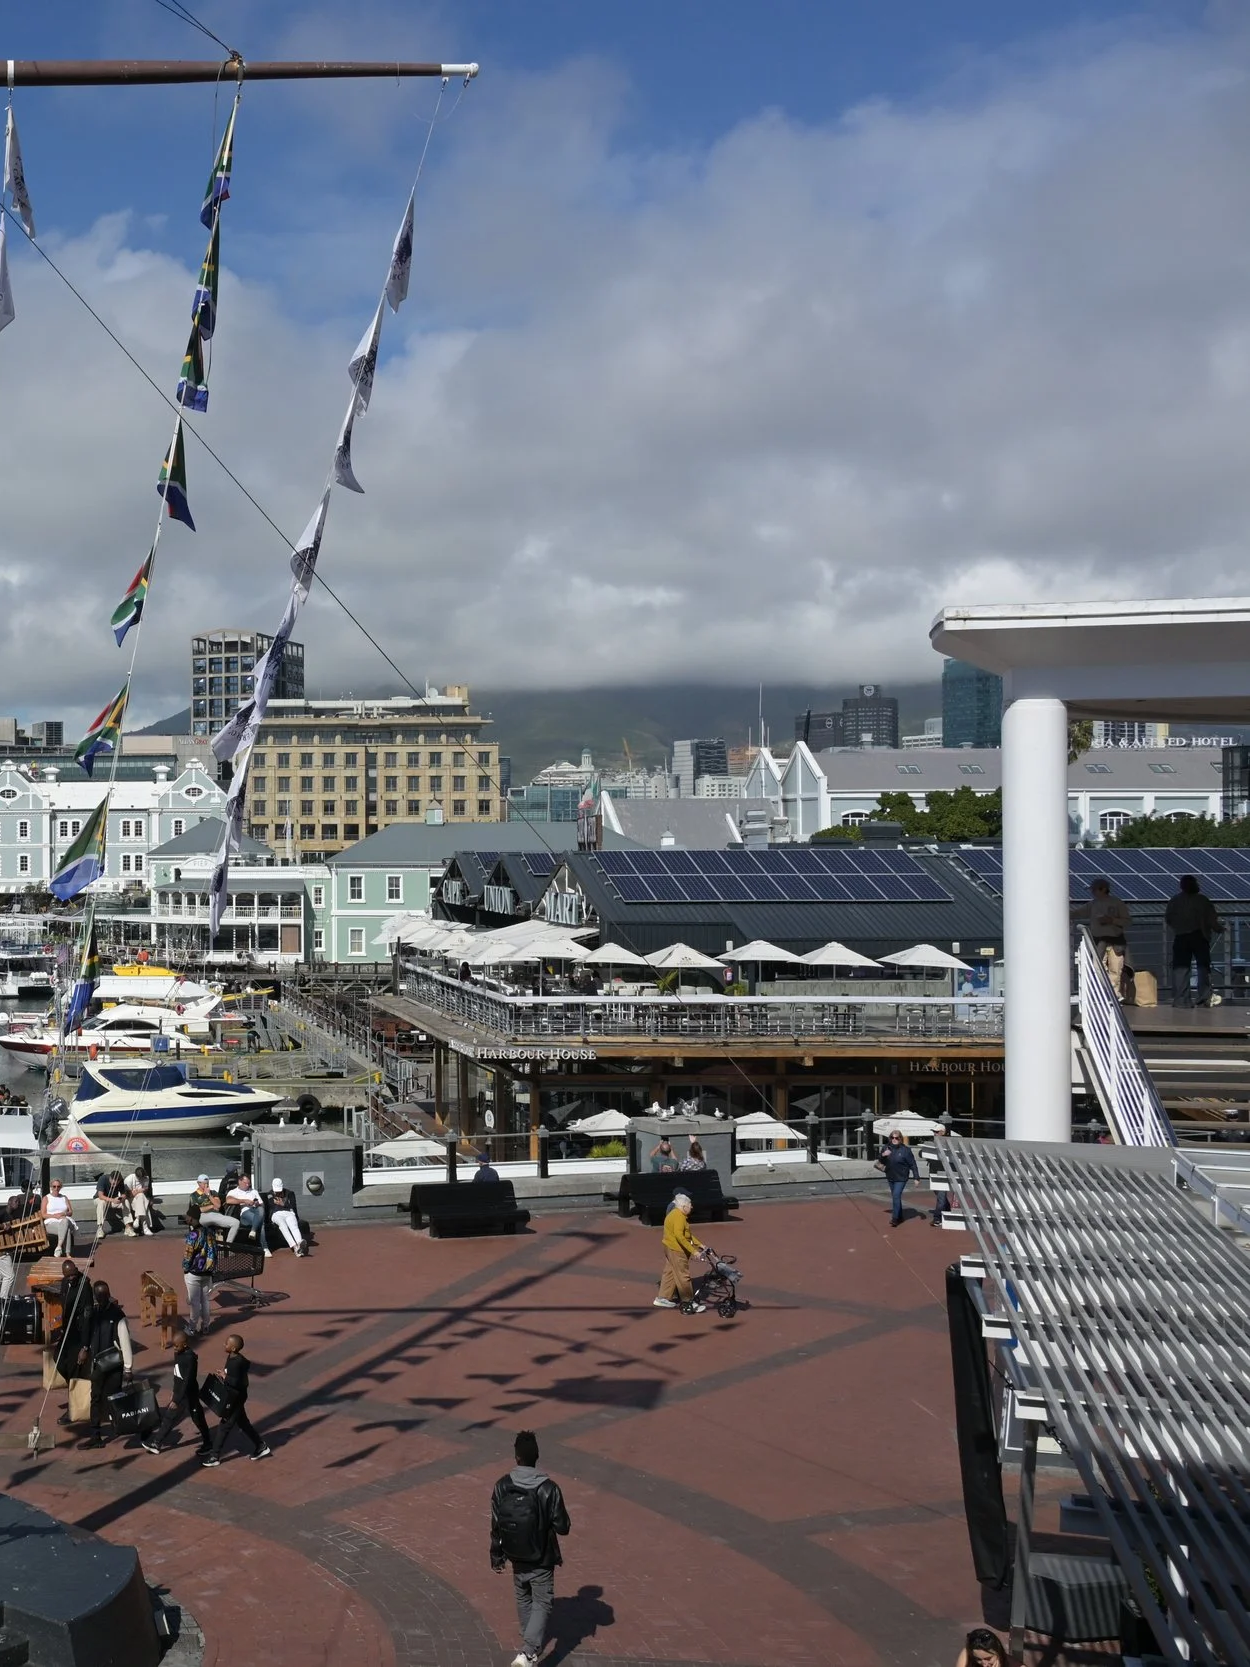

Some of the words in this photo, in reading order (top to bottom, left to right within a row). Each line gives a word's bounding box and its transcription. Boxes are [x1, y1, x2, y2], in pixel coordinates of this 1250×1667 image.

[1192, 736, 1238, 746] HOTEL
[442, 879, 461, 904] CAPE
[484, 885, 514, 915] UNION
[545, 892, 579, 925] MART
[477, 1047, 547, 1060] HARBOUR
[550, 1048, 597, 1060] HOUSE
[910, 1061, 977, 1072] HARBOUR
[981, 1061, 1005, 1072] HOU
[121, 1407, 150, 1419] FABIANI
